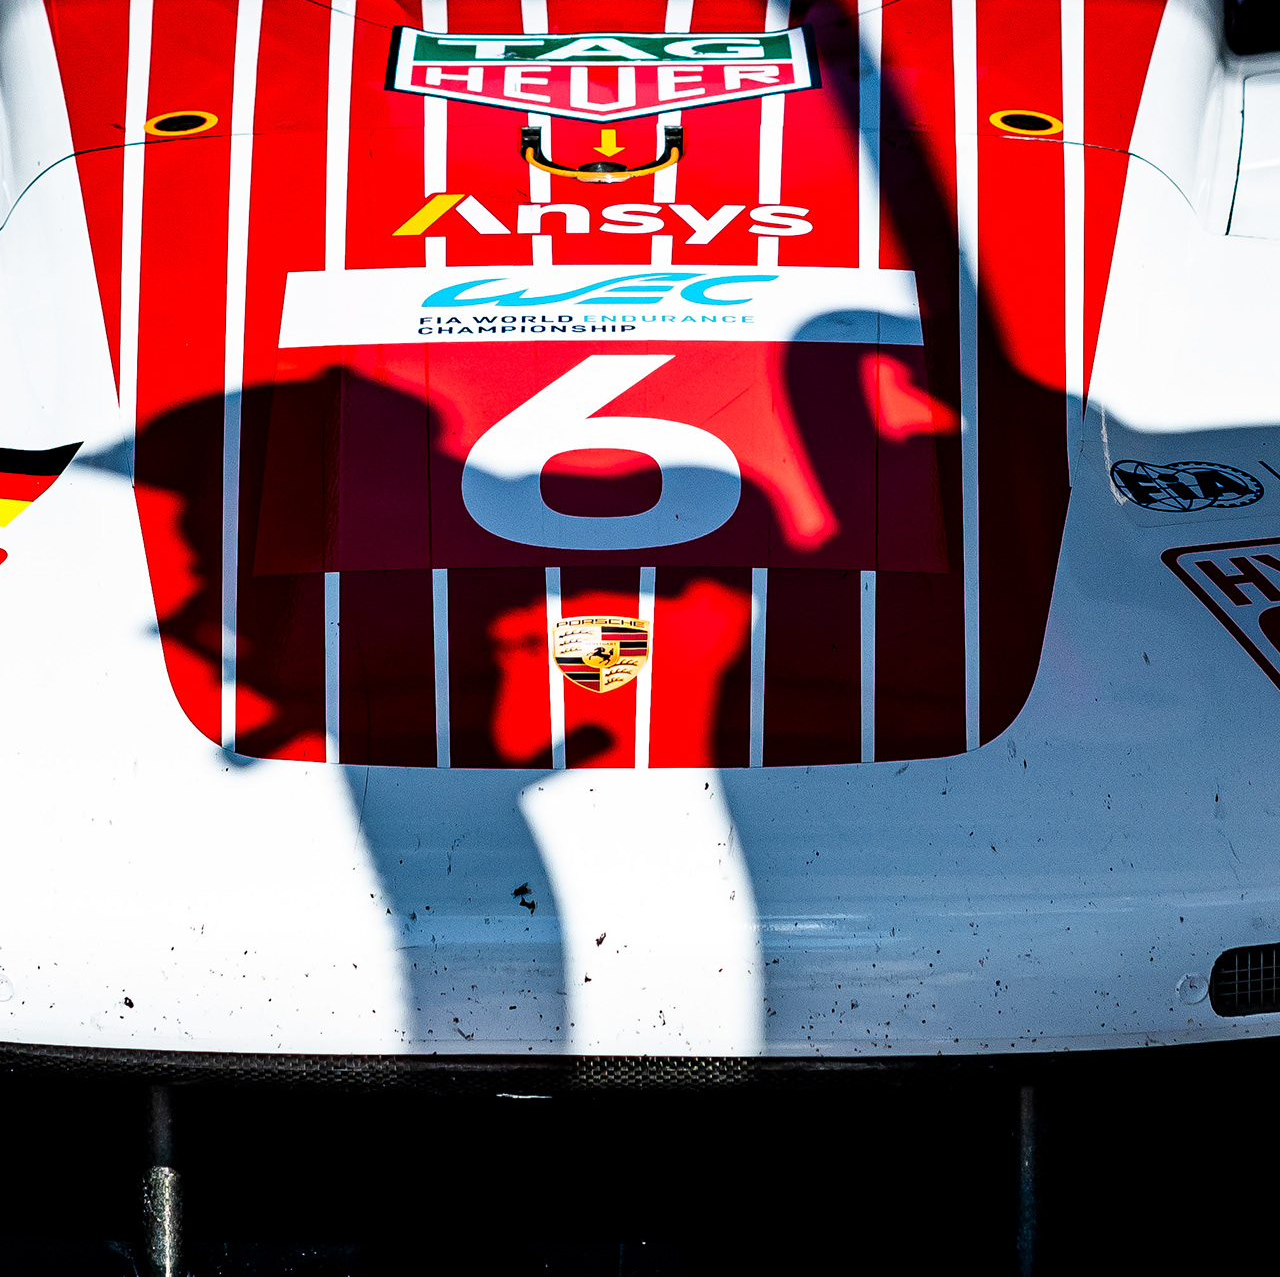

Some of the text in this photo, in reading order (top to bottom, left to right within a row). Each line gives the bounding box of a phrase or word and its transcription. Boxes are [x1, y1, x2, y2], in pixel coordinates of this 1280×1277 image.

[437, 37, 766, 60] TAG
[424, 63, 780, 112] HEUER
[391, 193, 814, 245] Ansys
[421, 272, 780, 307] WEC
[417, 324, 636, 335] CHAMPIONSHIP
[419, 314, 755, 325] FIA WORLD ENDURANCE
[461, 354, 742, 550] 6
[555, 618, 646, 628] PORSCHE
